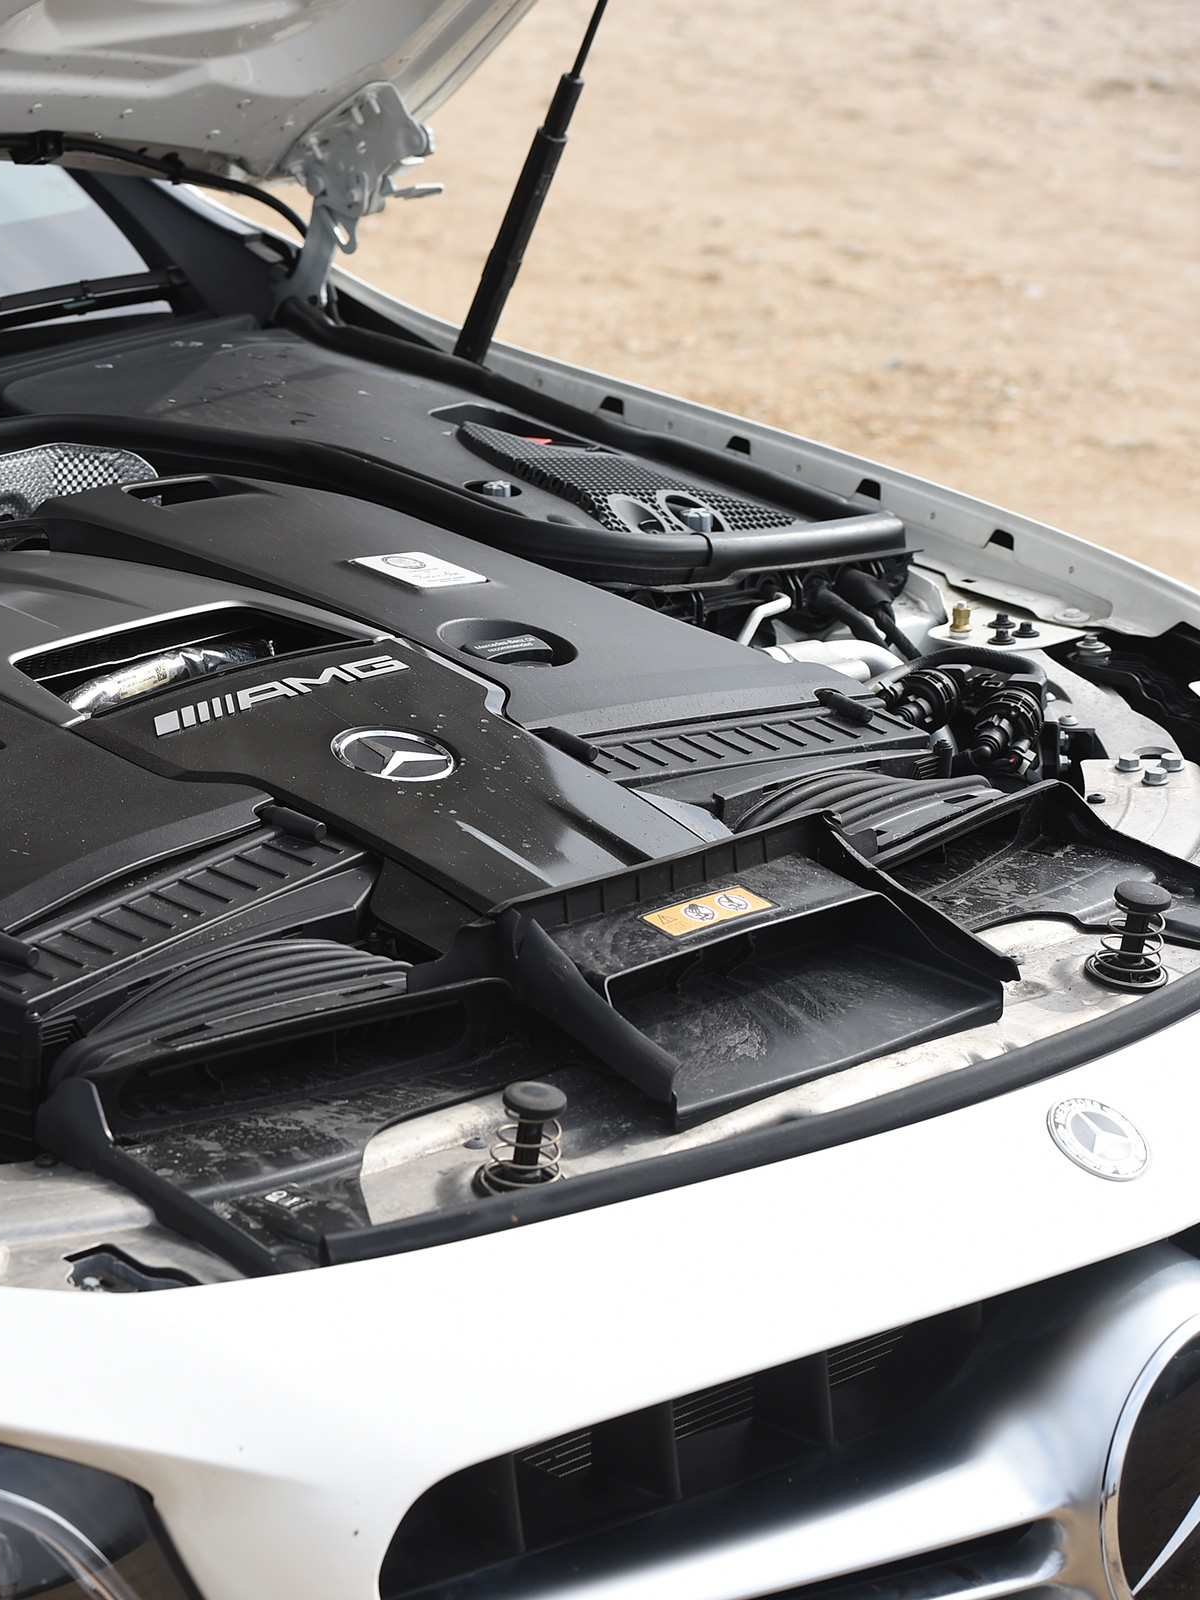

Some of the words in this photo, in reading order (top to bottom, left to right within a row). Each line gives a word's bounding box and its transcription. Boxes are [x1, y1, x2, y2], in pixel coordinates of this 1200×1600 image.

[473, 638, 525, 650] Mercedes-Benz
[487, 642, 533, 653] recommended
[236, 655, 409, 711] AMG
